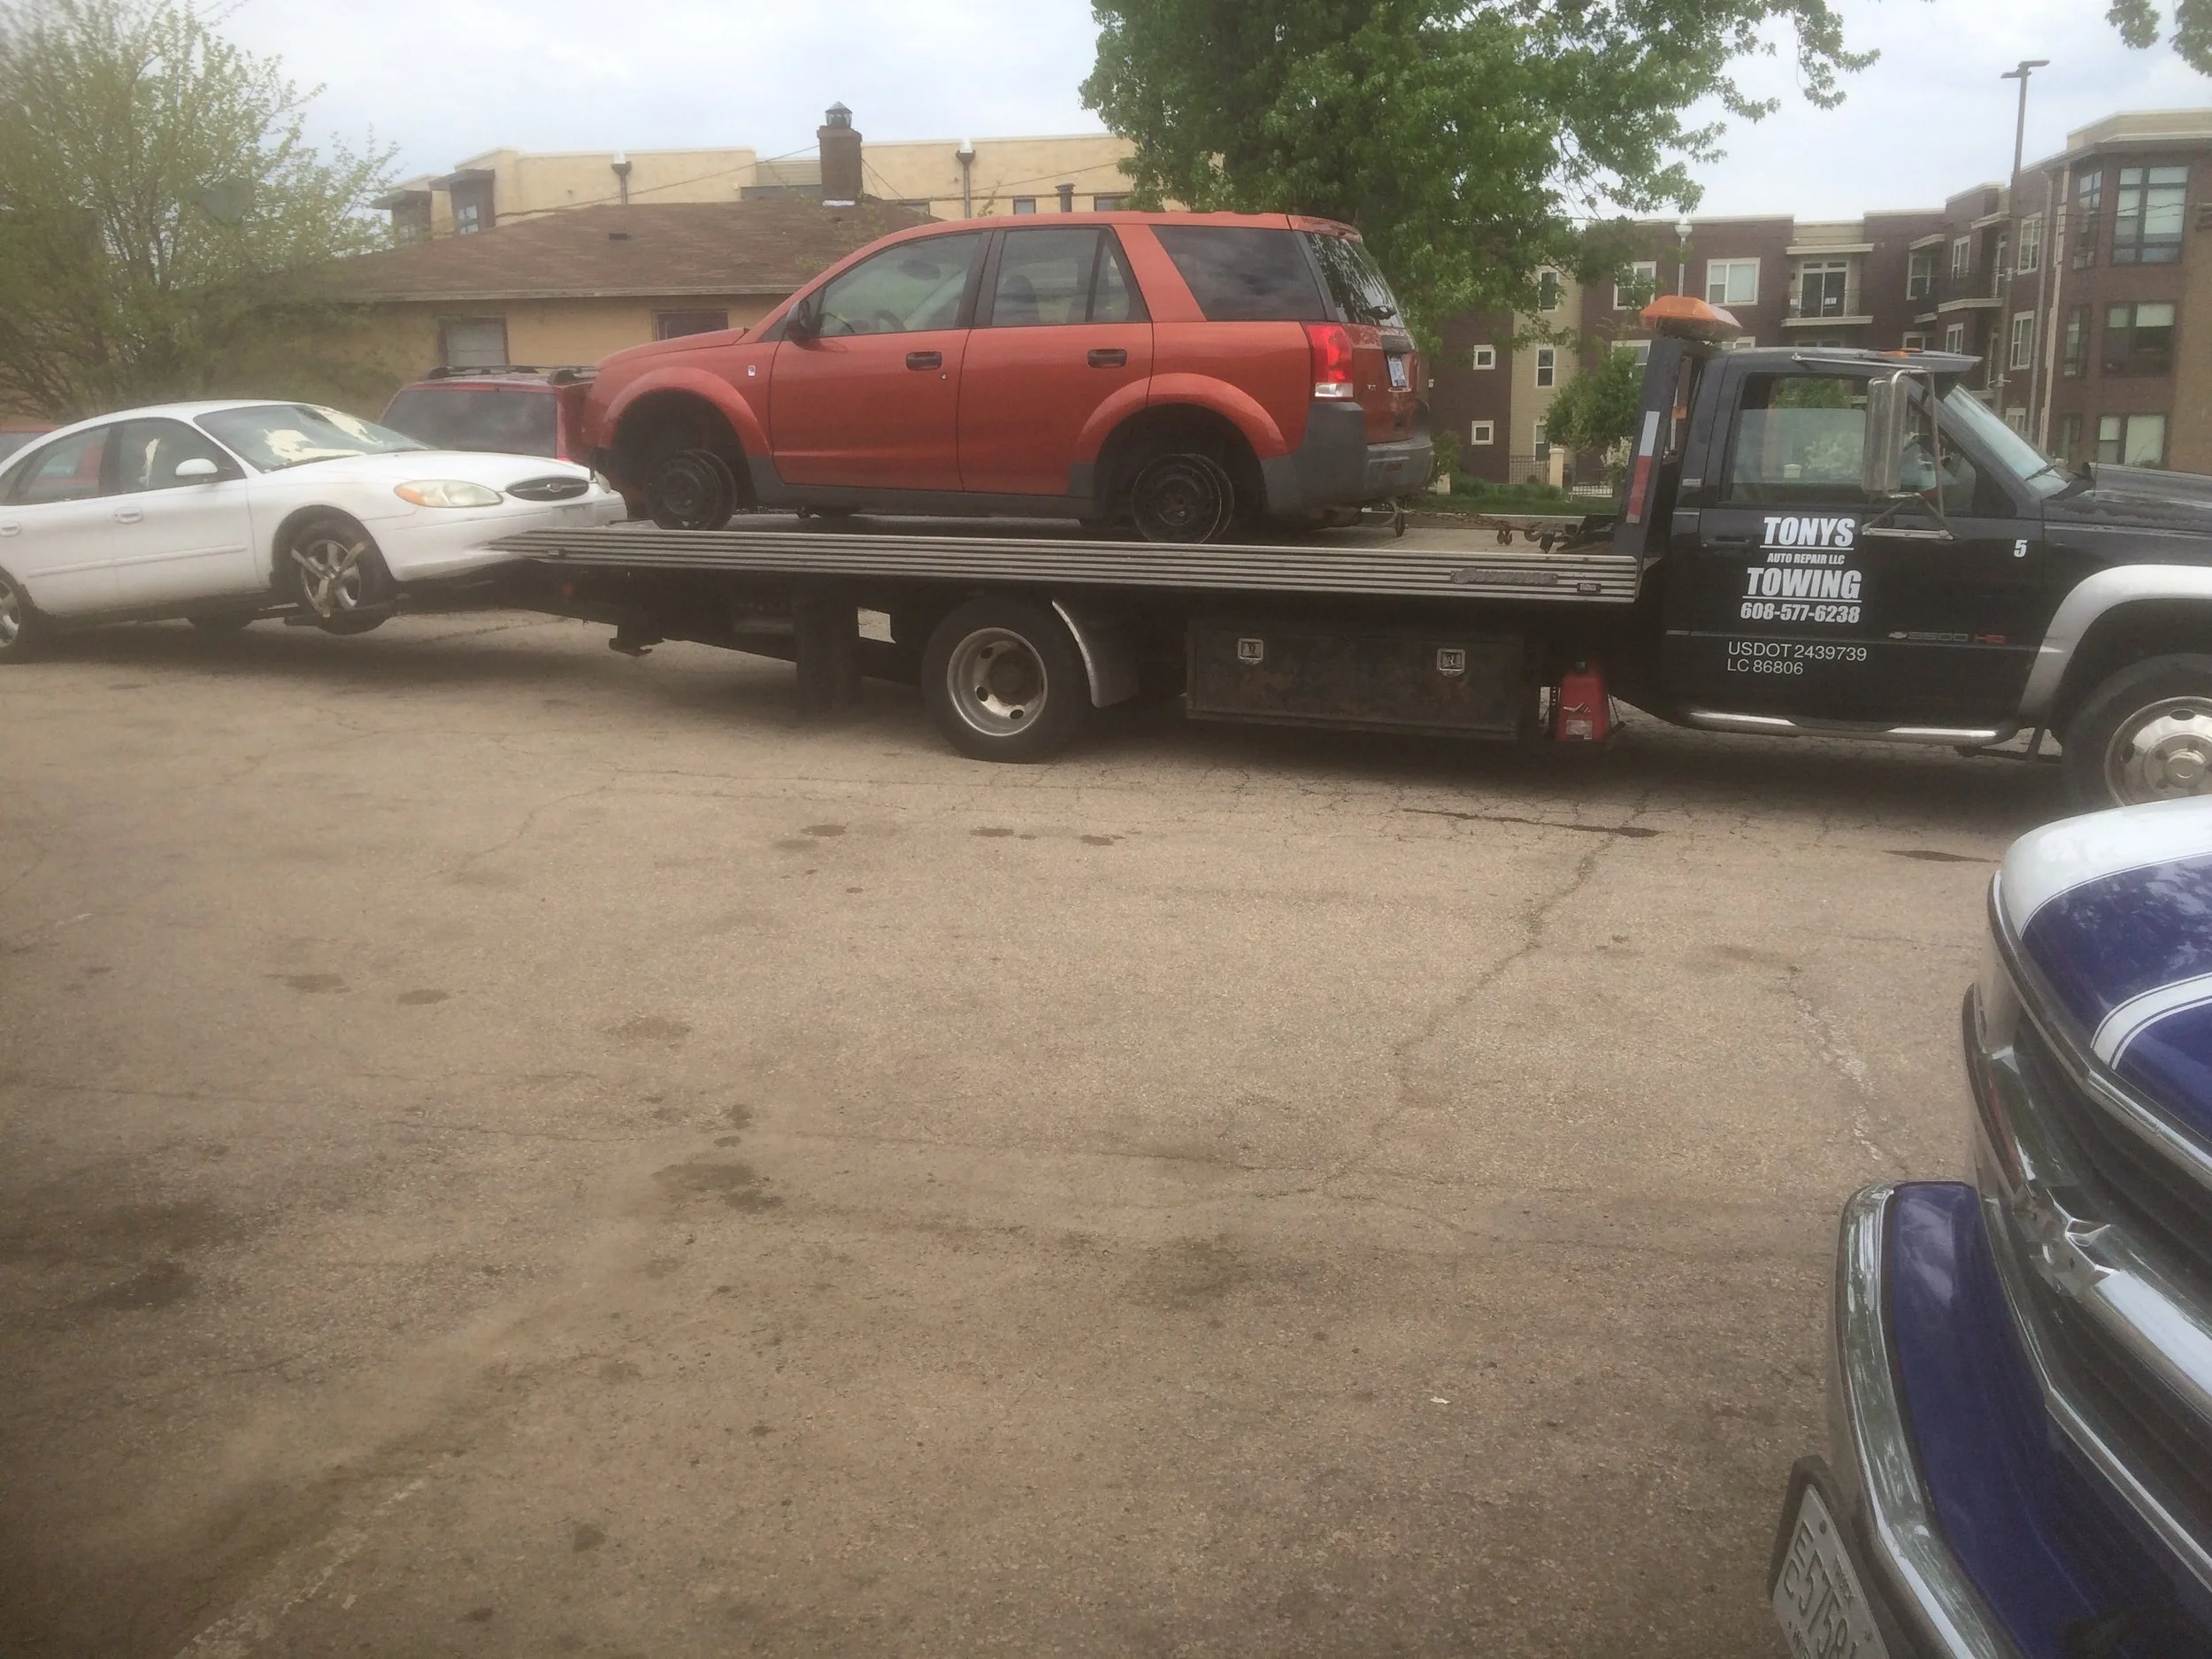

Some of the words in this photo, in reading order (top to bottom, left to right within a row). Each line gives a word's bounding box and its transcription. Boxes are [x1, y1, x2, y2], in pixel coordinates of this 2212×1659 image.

[1763, 517, 1855, 547] TONYS
[1767, 552, 1793, 565] AUTO
[1793, 553, 1828, 565] REPAIR
[1829, 555, 1846, 565] LLC
[2014, 540, 2028, 558] 5
[1747, 567, 1863, 599] TOWING
[1740, 602, 1861, 624] 608-577-6238
[1728, 641, 1792, 658] USDOT
[1793, 645, 1867, 662] 2439739
[1727, 658, 1749, 672] LC
[1753, 660, 1804, 675] 86806
